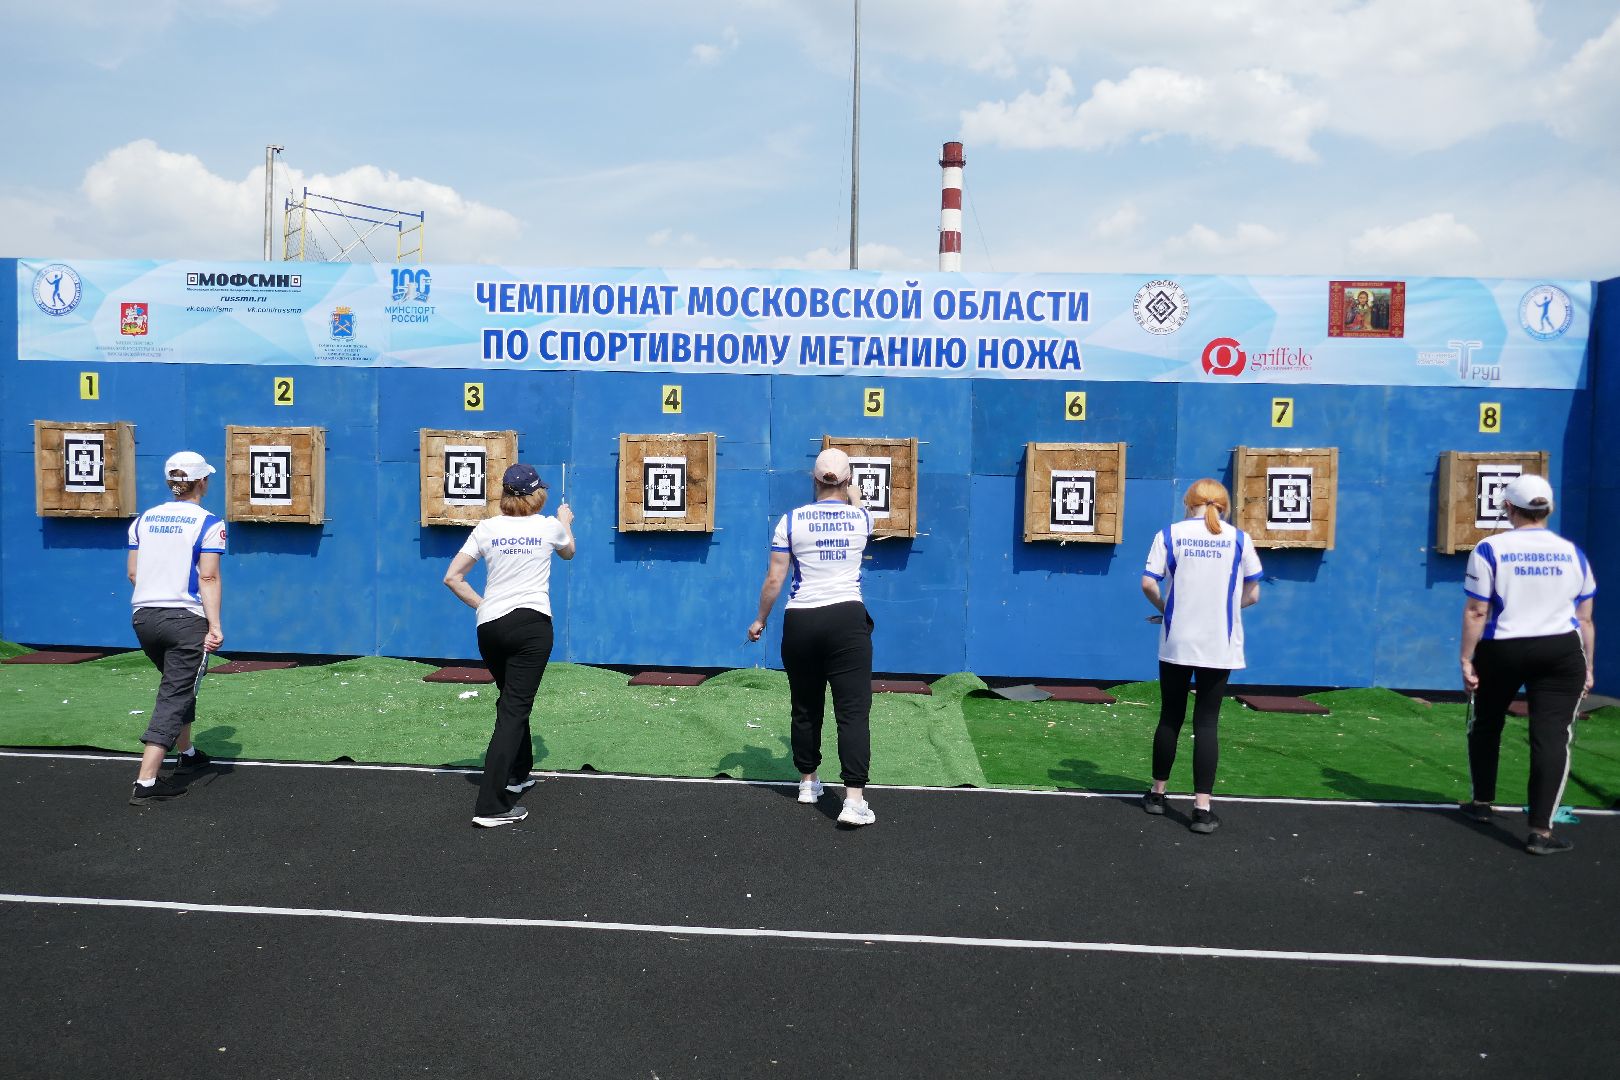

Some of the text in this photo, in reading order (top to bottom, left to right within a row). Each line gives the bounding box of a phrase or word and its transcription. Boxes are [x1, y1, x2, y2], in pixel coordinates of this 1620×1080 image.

[199, 273, 290, 287] МОФСМН
[476, 280, 1089, 322] ЧЕМПИОНАТ МОСКОВСКОЙ ОБЛАСТИ
[247, 306, 302, 314] vk.com/russmn
[385, 306, 435, 315] МИНСПОРТ
[391, 315, 429, 323] РОССИИ
[483, 329, 1082, 371] ПО СПОРТИВНОМУ МЕТАНИЮ НОЖА
[1250, 347, 1313, 371] griffele
[86, 376, 93, 396] 1
[278, 381, 291, 401] 2
[466, 386, 480, 407] 3
[664, 388, 680, 410] 4
[866, 392, 881, 414] 5
[1068, 396, 1083, 419] 6
[1274, 402, 1290, 423] 7
[1483, 407, 1497, 431] 8
[145, 515, 197, 524] МОСКОВСКАЯ
[797, 510, 862, 521] МОСКОВСКАЯ
[149, 525, 183, 534] ОБЛАСТЬ
[808, 522, 855, 533] ОБЛАСТЬ
[491, 537, 542, 547] МОФСМН
[815, 538, 850, 548] ФОКША
[1176, 538, 1231, 549] МОСКОВСКАЯ
[819, 550, 847, 561] ОЛЕСЯ
[1184, 548, 1222, 559] ОБЛАСТЬ
[1500, 552, 1573, 563] МОСКОВСКАЯ
[1514, 566, 1563, 576] ОБЛАСТЬ
